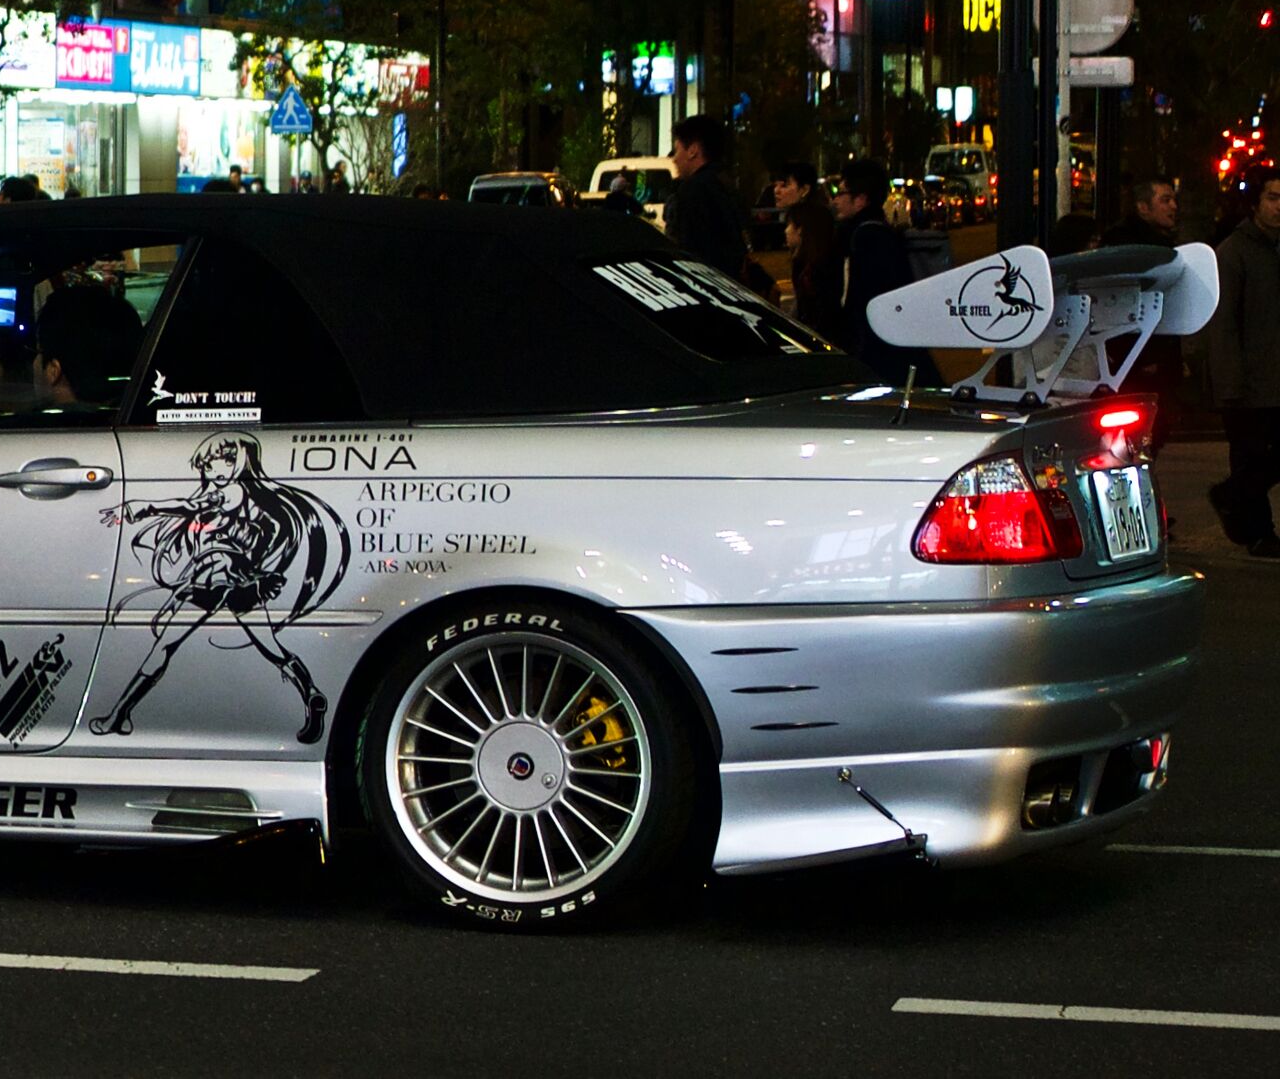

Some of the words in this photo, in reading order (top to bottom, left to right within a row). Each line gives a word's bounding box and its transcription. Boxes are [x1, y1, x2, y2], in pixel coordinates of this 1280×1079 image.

[949, 305, 968, 317] BLUE
[970, 305, 992, 317] STEEL
[175, 392, 209, 404] DON'T
[214, 391, 257, 404] TOUCH!
[291, 433, 369, 443] SUBMARINE
[289, 446, 417, 472] IONA
[357, 482, 511, 504] ARPEGGIO
[355, 507, 396, 528] OF
[359, 532, 434, 554] BLUE
[443, 533, 537, 555] STEEL
[426, 612, 565, 652] FEDERAL
[540, 889, 596, 919] 595
